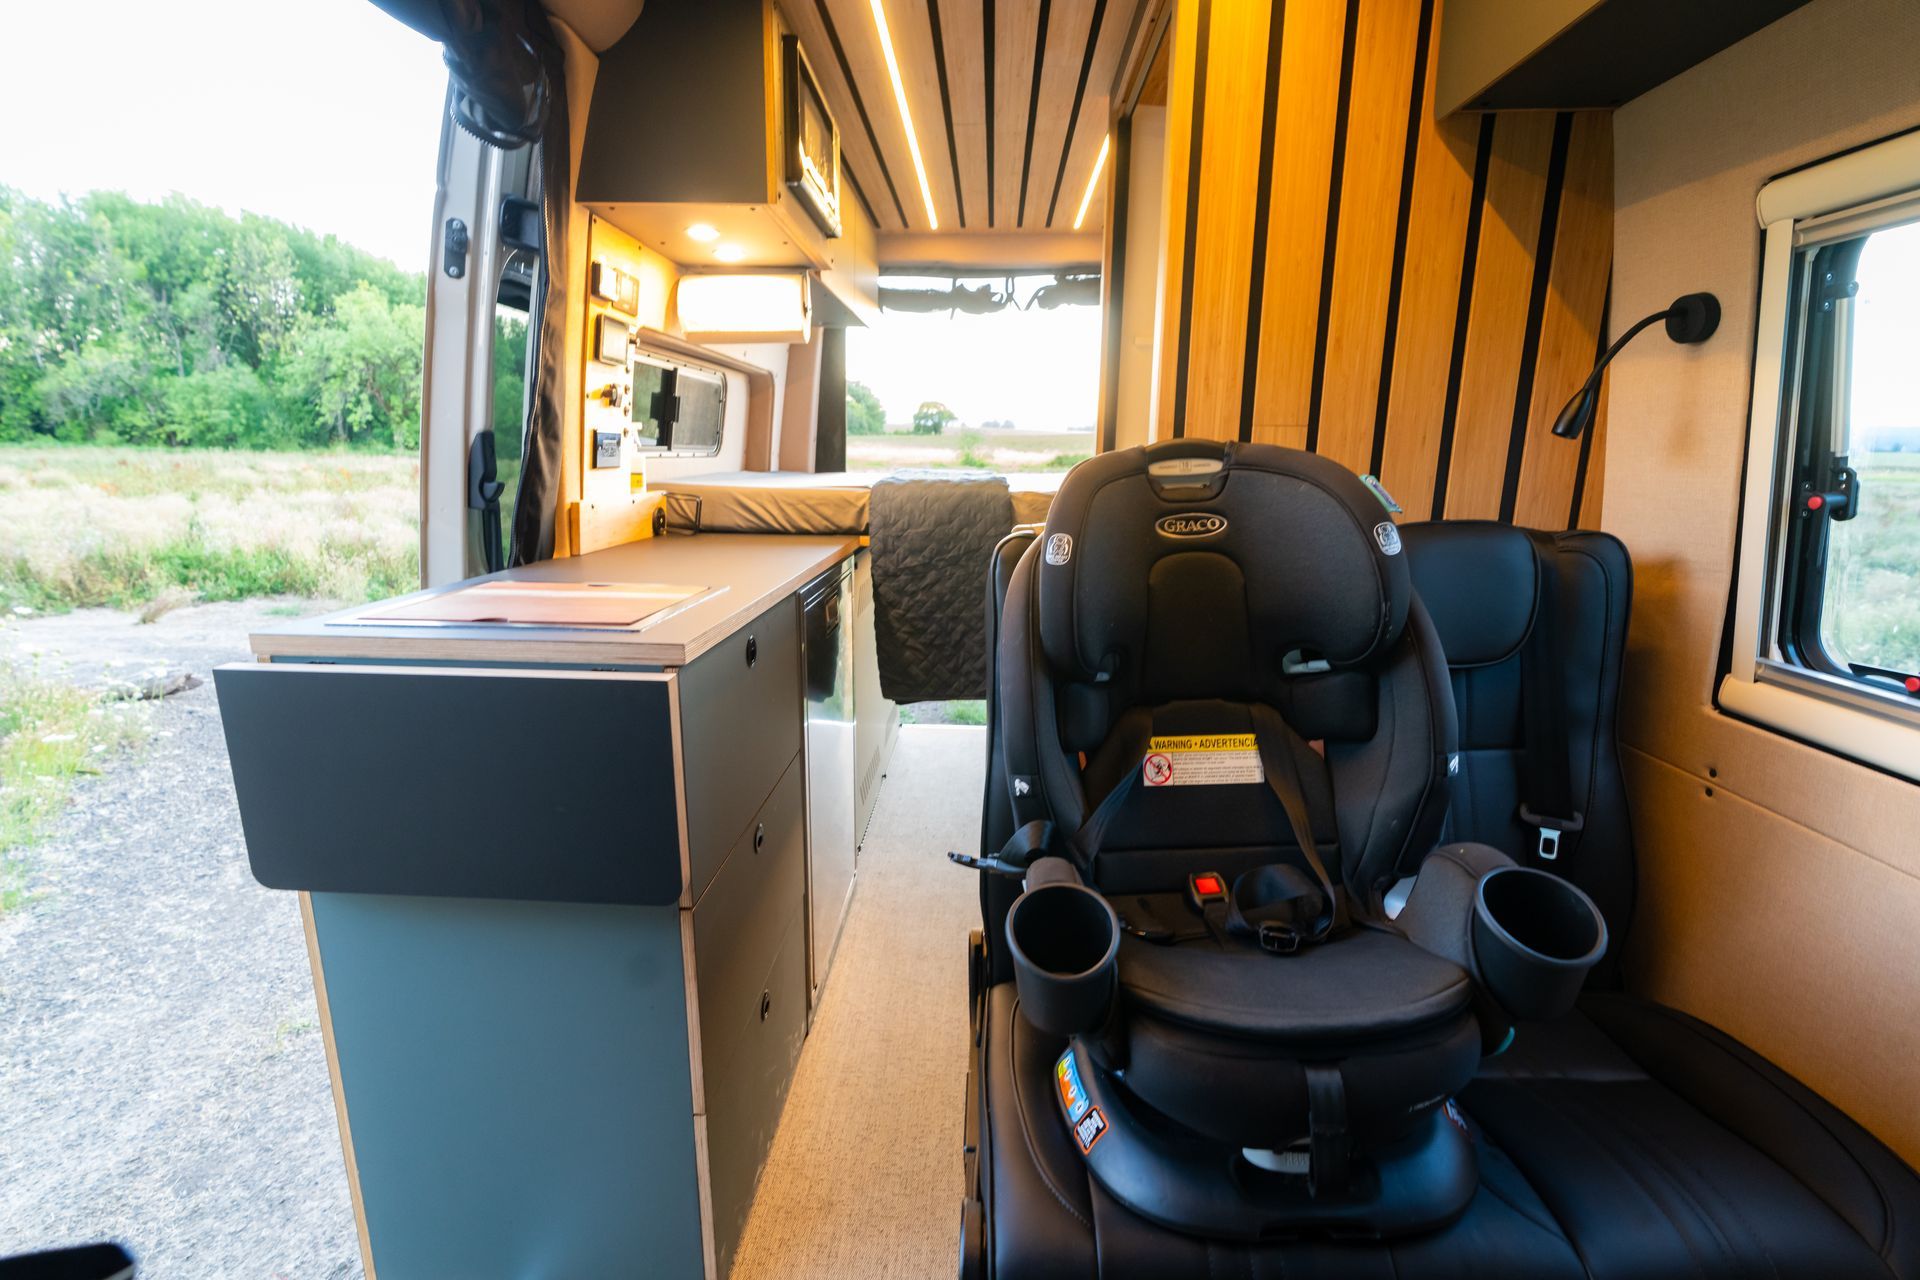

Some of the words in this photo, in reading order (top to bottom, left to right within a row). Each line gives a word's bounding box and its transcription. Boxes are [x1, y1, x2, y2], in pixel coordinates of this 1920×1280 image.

[1164, 518, 1219, 533] GRACO
[1154, 738, 1193, 751] WARNING
[1199, 736, 1258, 749] ADVERTENCIA
